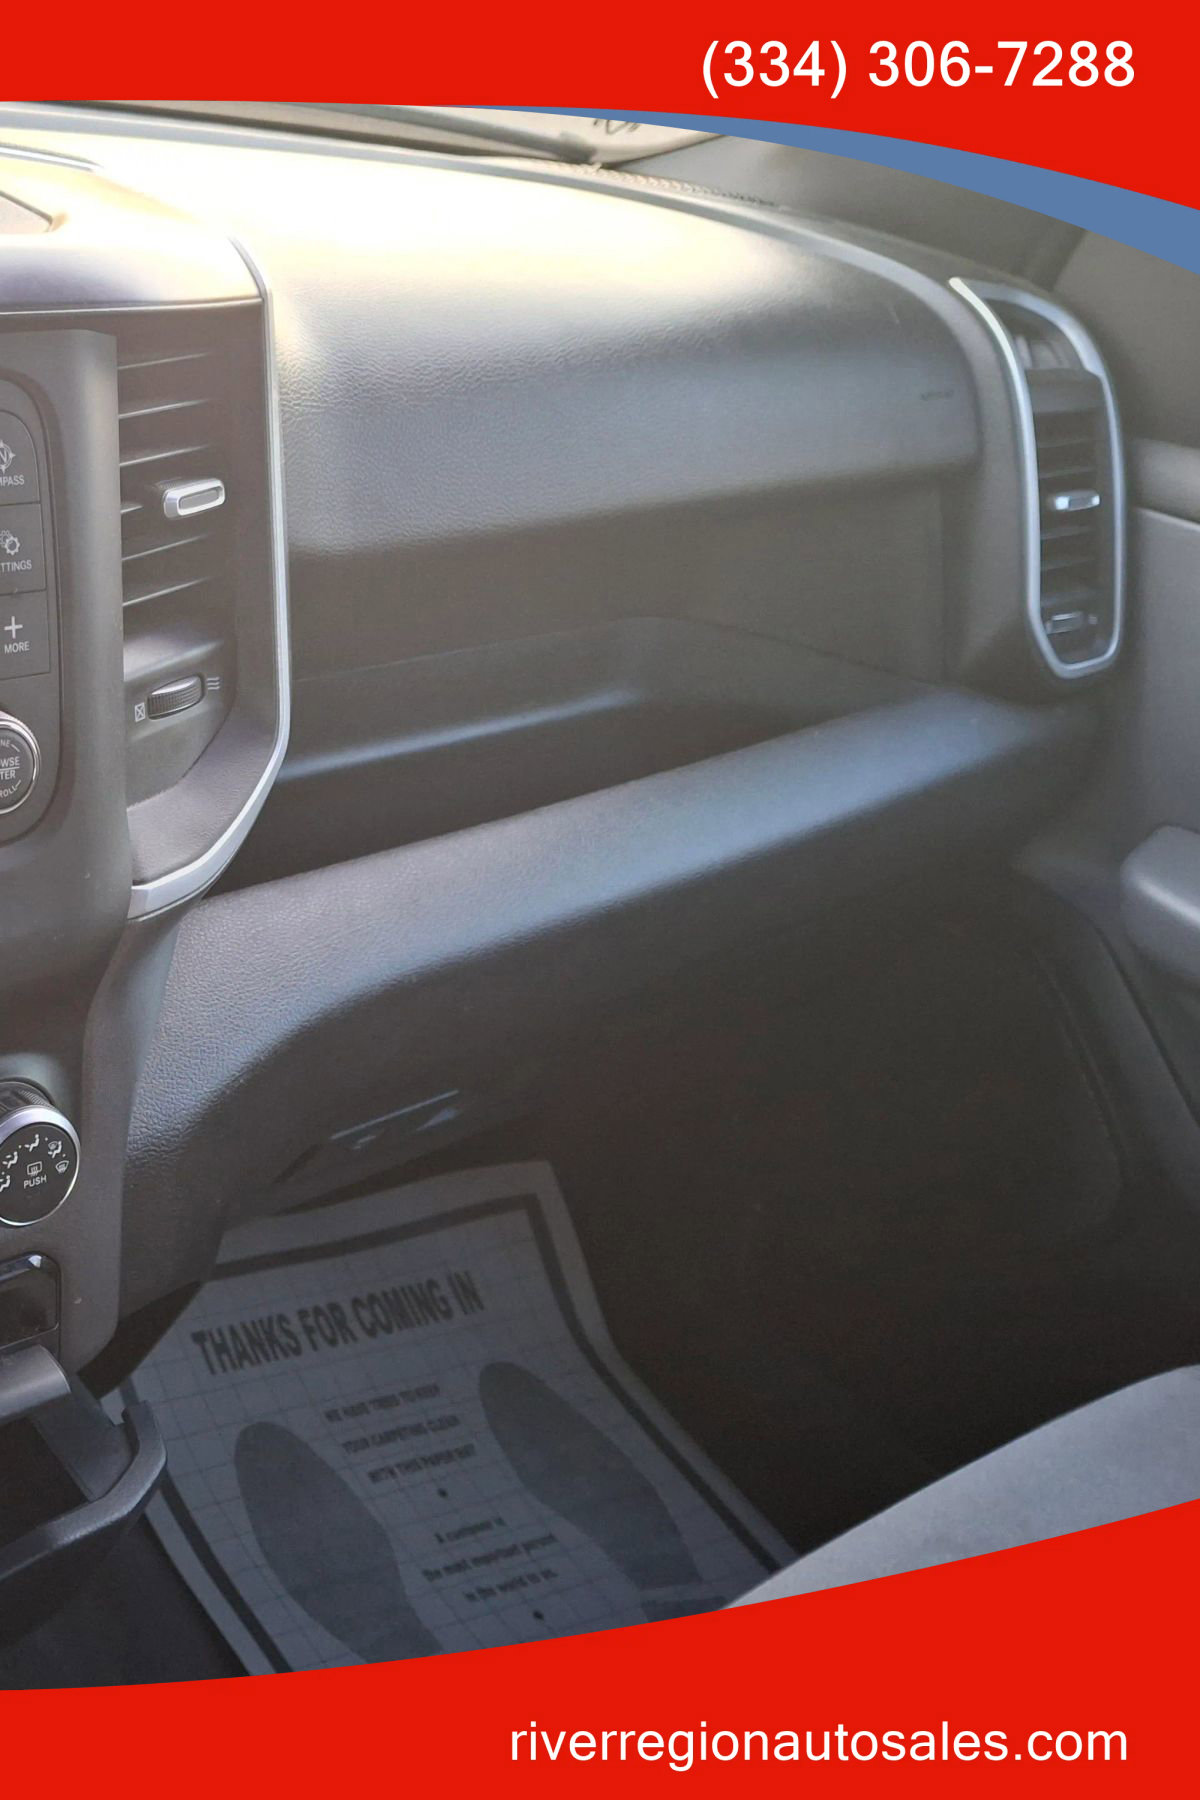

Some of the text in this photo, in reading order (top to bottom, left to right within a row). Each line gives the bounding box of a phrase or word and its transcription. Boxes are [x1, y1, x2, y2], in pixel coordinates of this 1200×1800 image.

[4, 641, 30, 655] MORE
[22, 1173, 47, 1189] PUSH
[190, 1269, 485, 1375] THANKS FOR COMING IN
